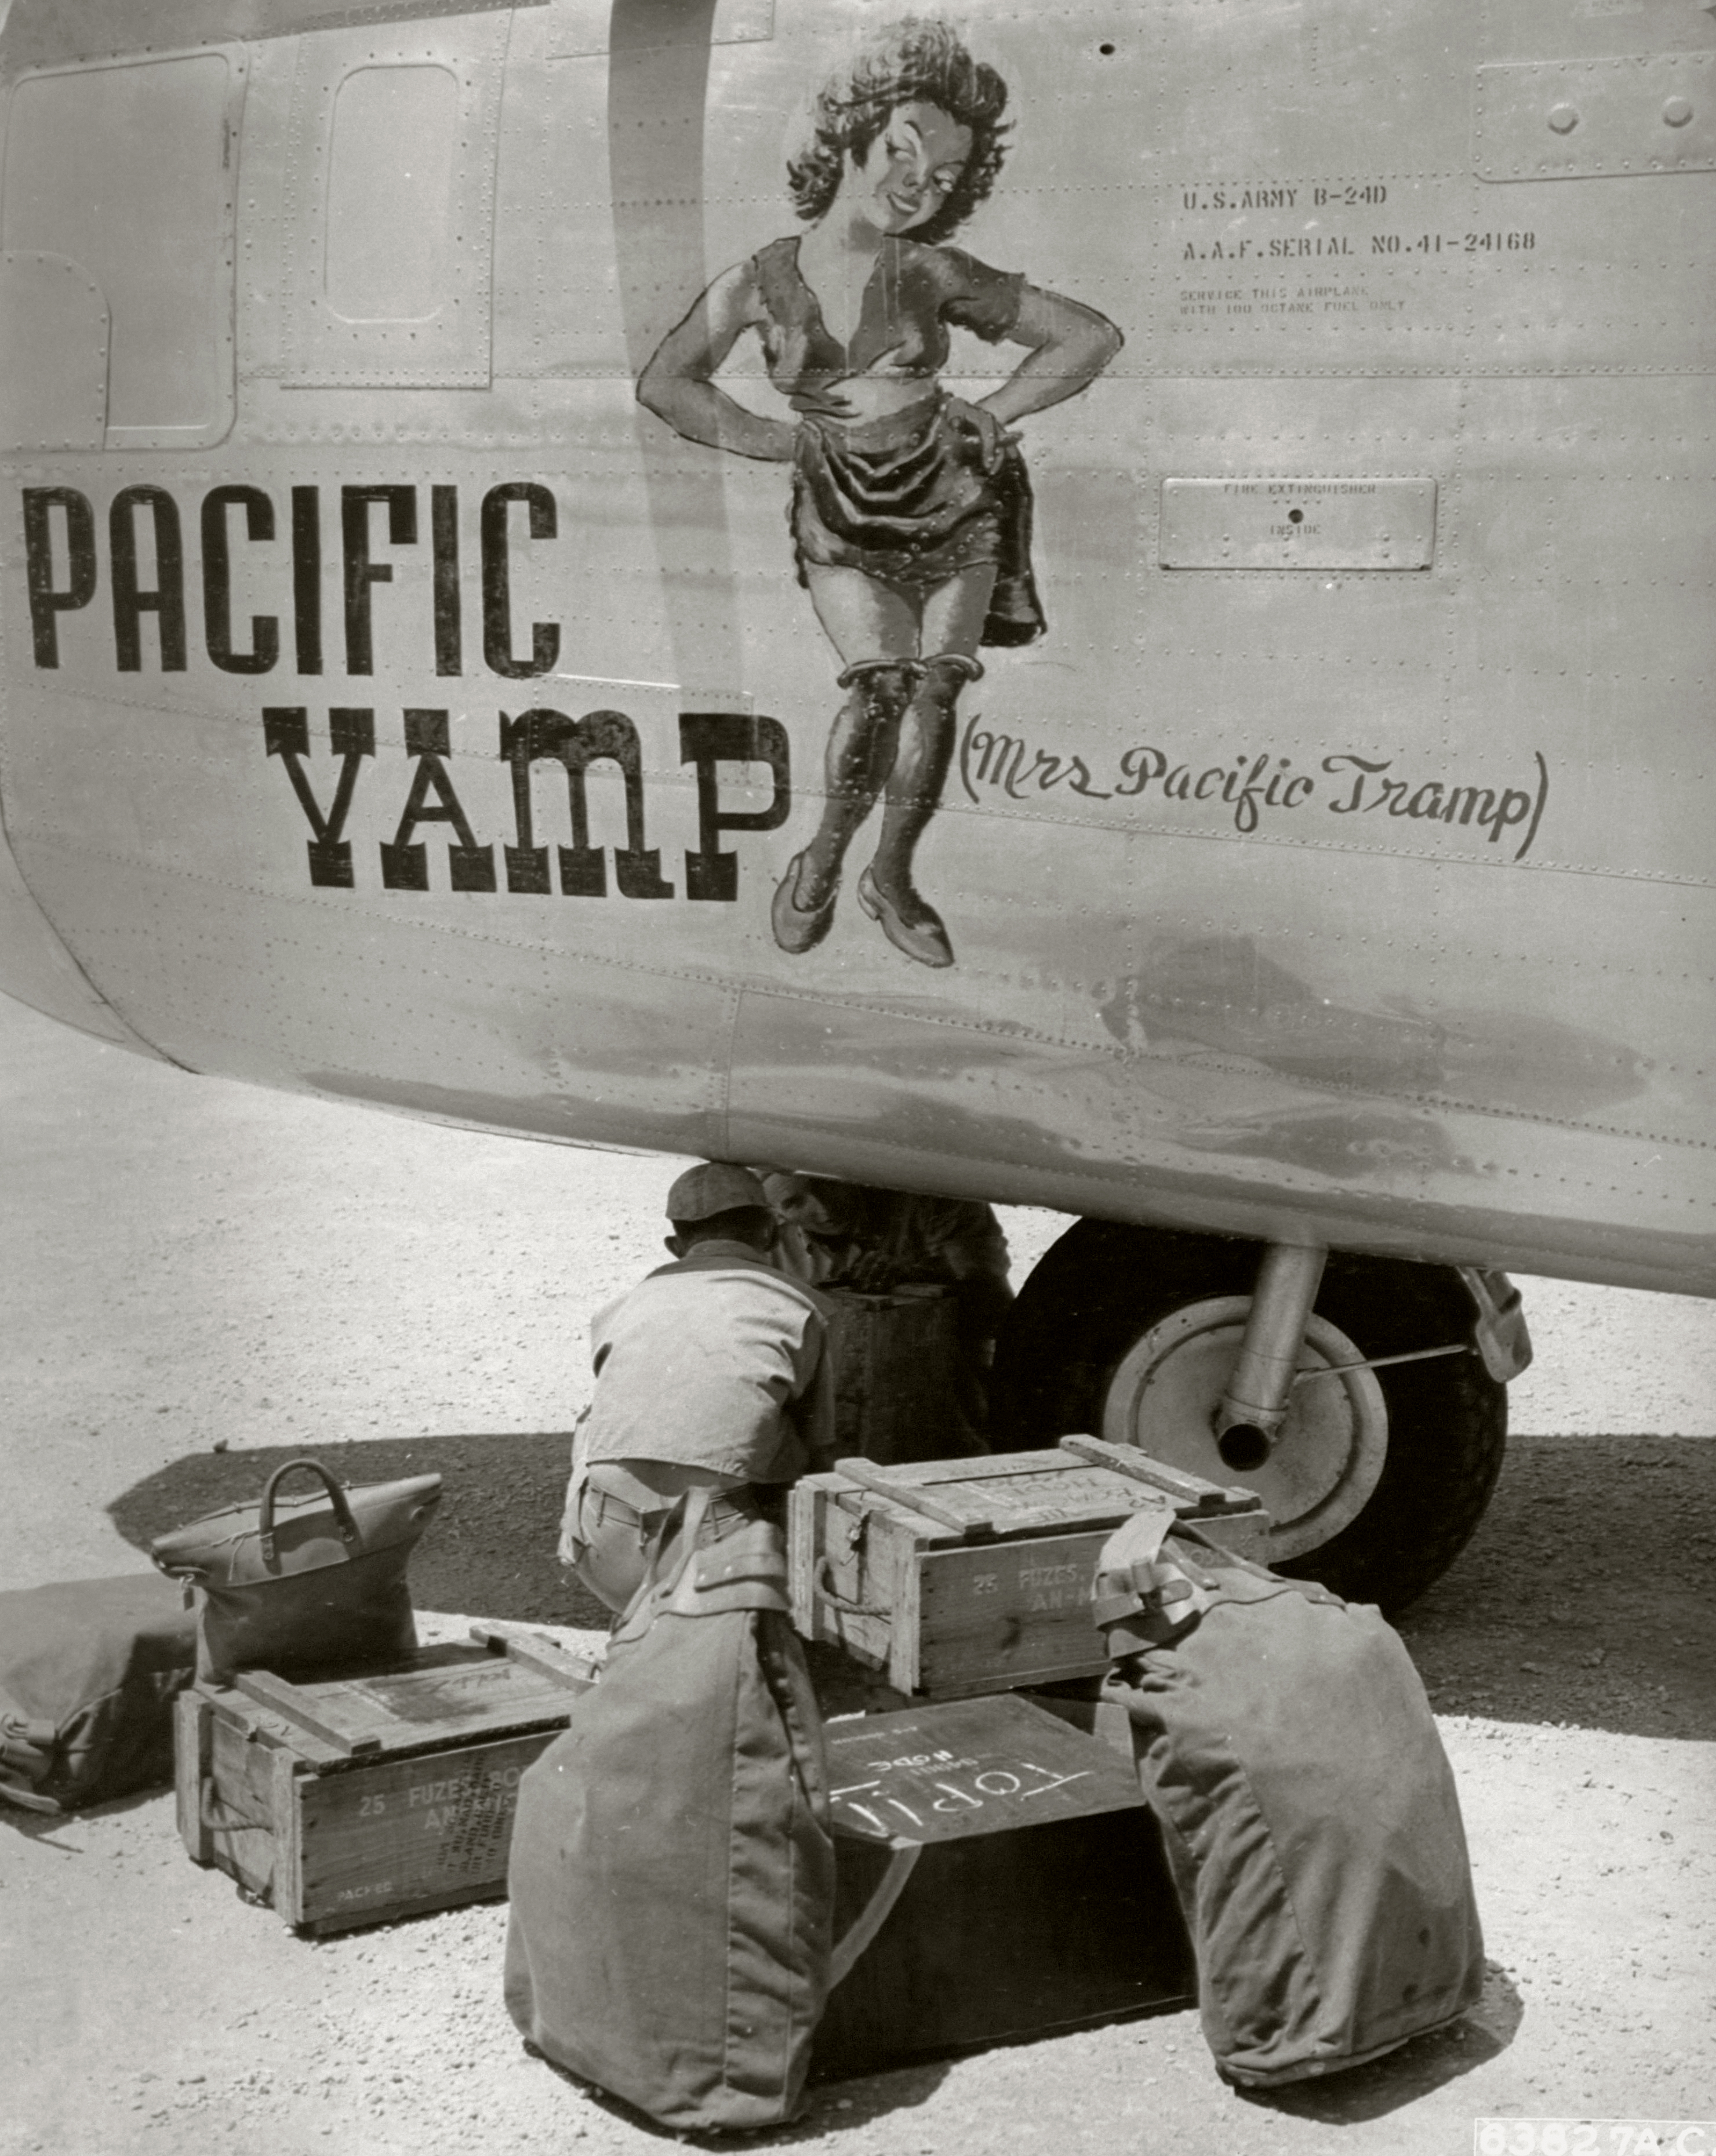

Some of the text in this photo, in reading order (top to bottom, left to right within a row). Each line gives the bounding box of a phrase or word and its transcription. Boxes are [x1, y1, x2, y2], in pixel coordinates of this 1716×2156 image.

[1314, 184, 1387, 206] B-24D
[1180, 285, 1369, 302] SERVICE THIS AIRPLANE
[1179, 300, 1406, 315] WITH 100 OCTANE FUEL ONLY
[1223, 483, 1376, 495] FIRE EXTINGUISHER
[1269, 523, 1322, 536] INSIDE
[22, 482, 561, 678] PACIFIC
[1115, 747, 1314, 832] Pacific
[1321, 751, 1548, 860] Tramp)
[972, 1573, 998, 1595] 25
[359, 1794, 386, 1817] 25
